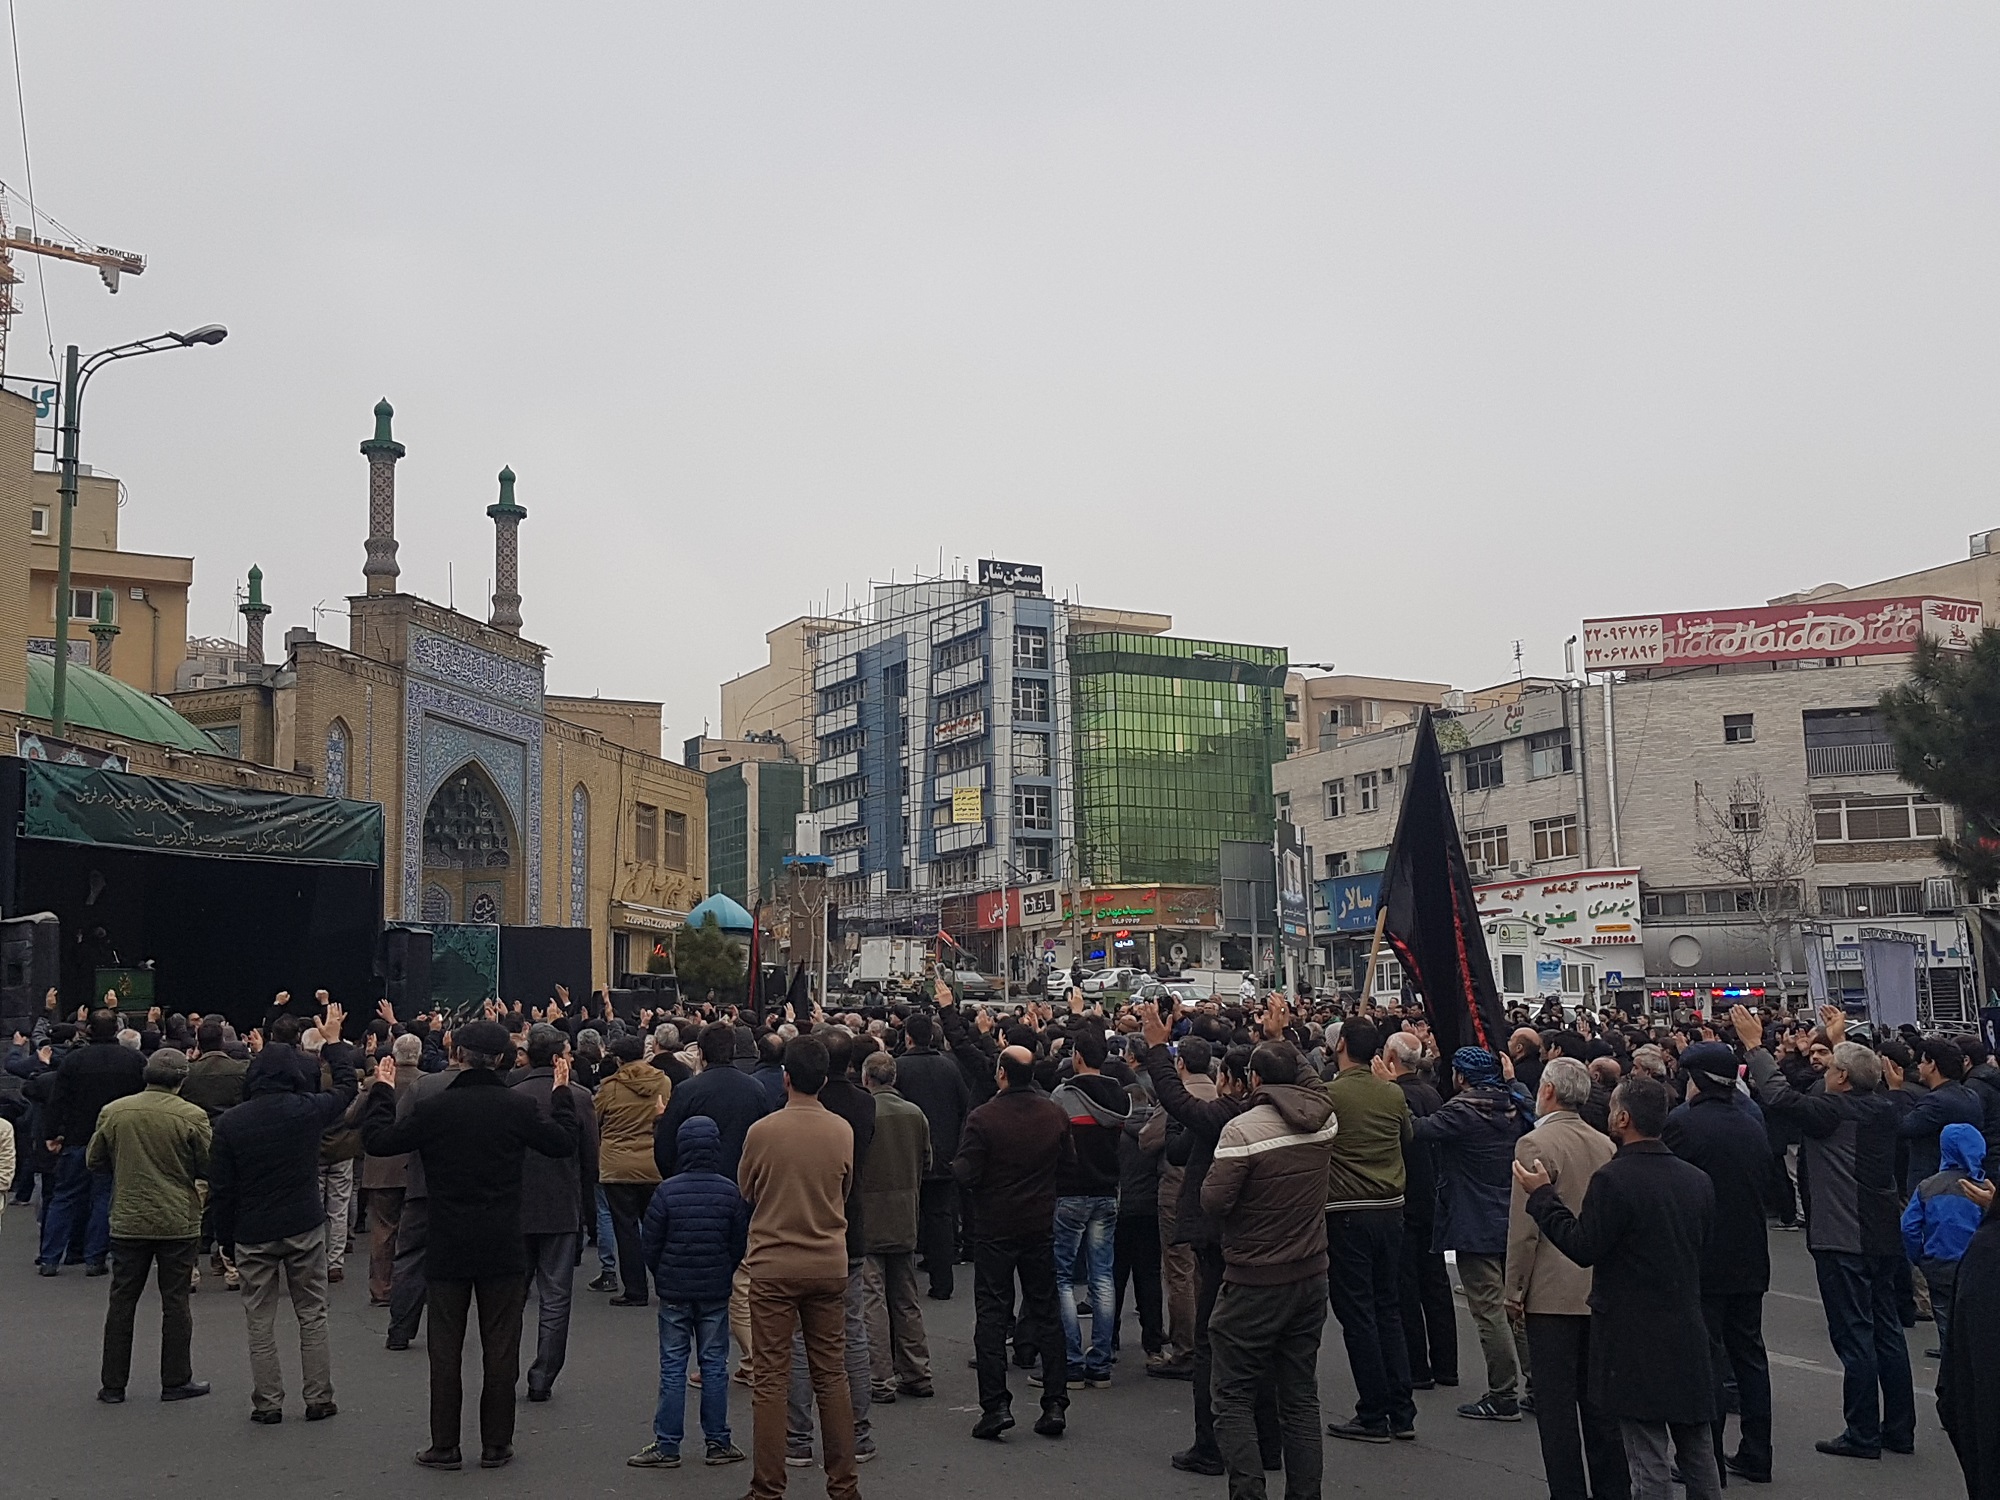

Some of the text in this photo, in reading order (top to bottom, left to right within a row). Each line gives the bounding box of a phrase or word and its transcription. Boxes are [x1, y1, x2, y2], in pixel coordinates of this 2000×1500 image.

[96, 245, 143, 262] ZOOMLION
[1003, 566, 1041, 586] مسکن
[1939, 603, 1980, 623] HOT
[1585, 624, 1659, 643] ۲۲۰۹۴۷۴۶
[1585, 643, 1658, 663] ۲۲۰۶۲۸۹۴
[1585, 877, 1633, 891] حلیم و عدسی
[1338, 885, 1373, 919] سالار
[1588, 900, 1618, 919] مهدی
